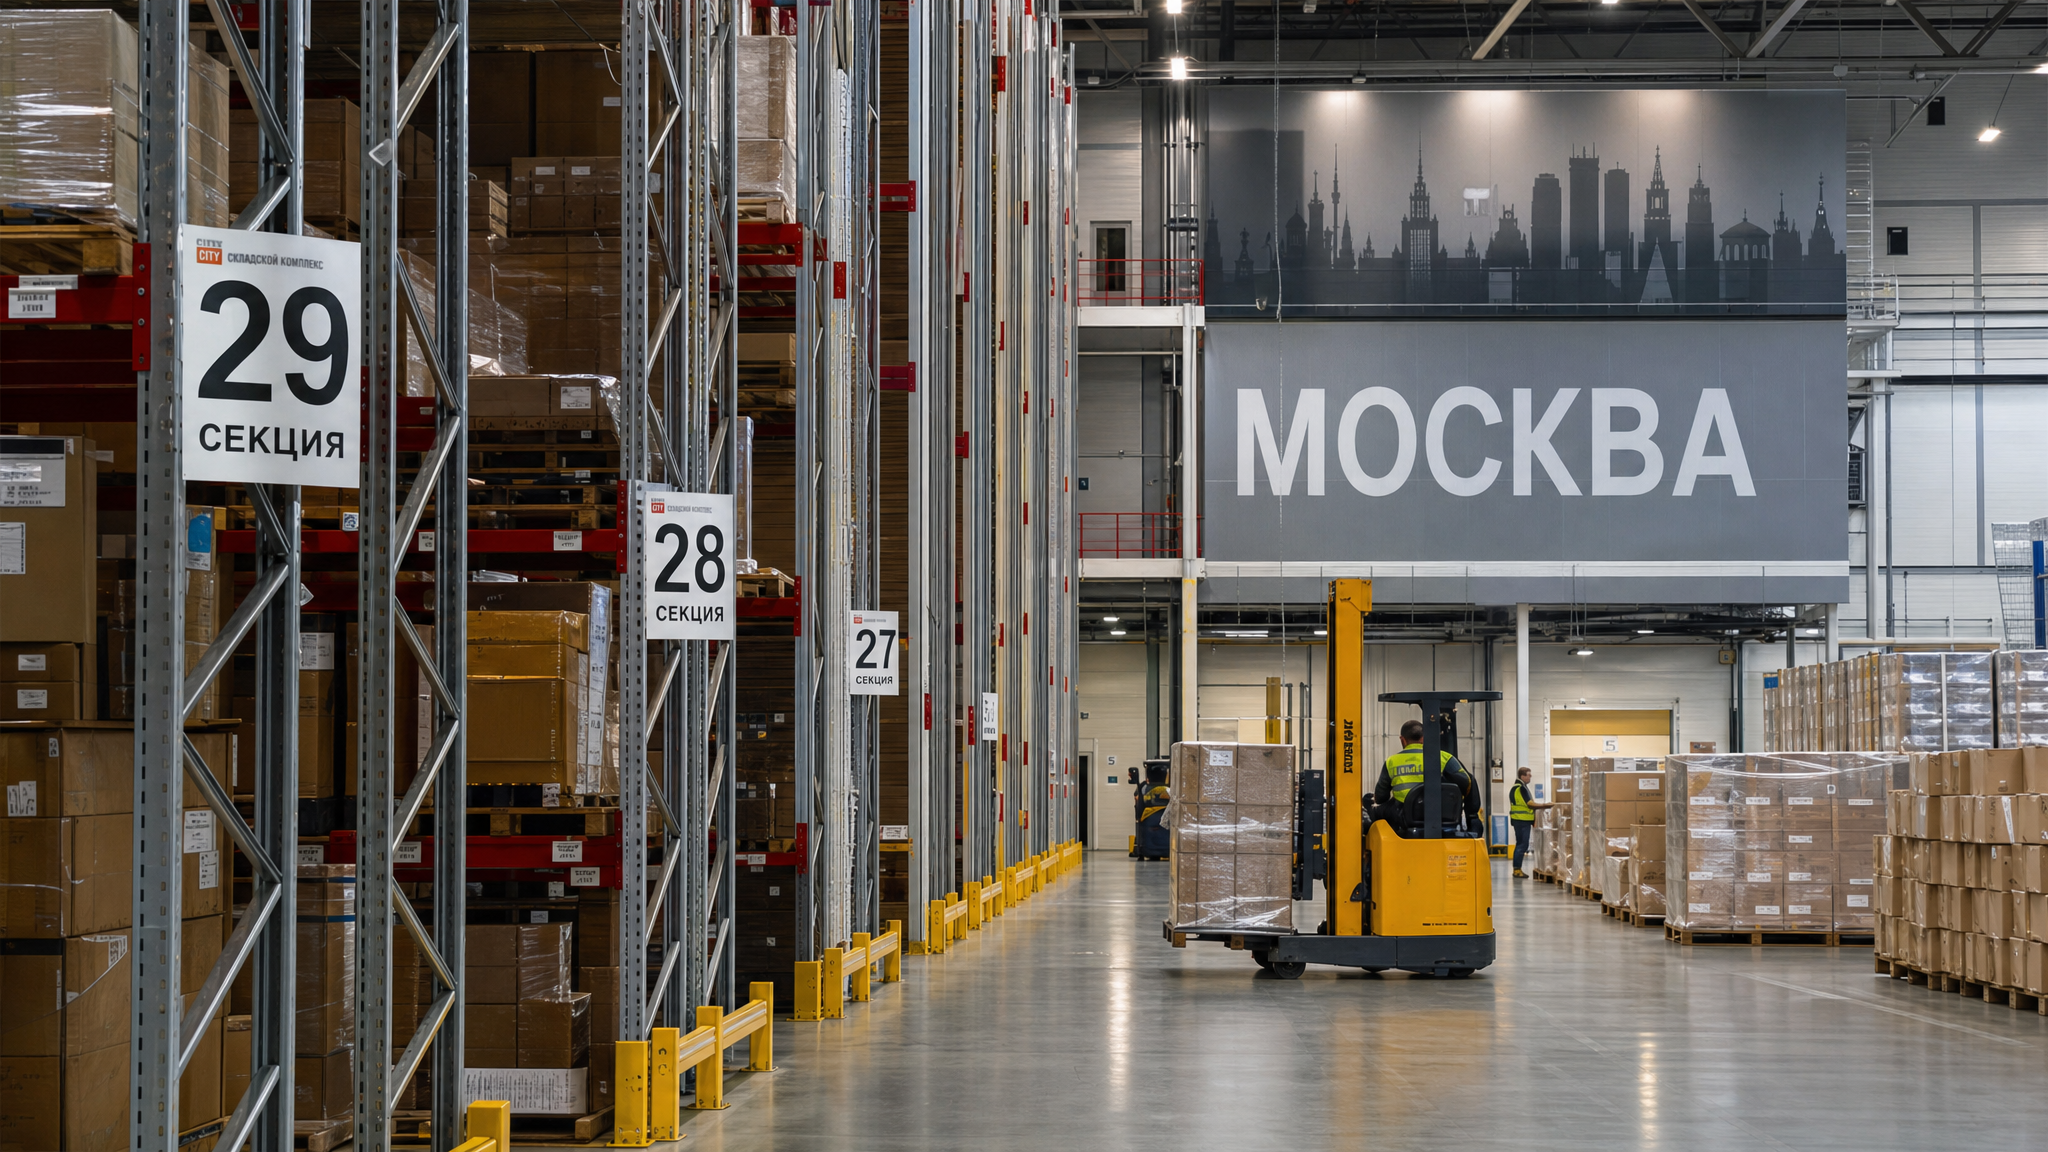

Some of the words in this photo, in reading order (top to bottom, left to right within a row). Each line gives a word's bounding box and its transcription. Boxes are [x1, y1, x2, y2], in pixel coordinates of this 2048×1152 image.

[199, 249, 220, 262] CITY
[227, 252, 278, 266] СКЛАДСКОЙ
[198, 280, 349, 406] 29
[199, 423, 344, 462] СЕКЦИЯ
[1237, 386, 1757, 497] МОСКВА
[654, 523, 725, 593] 28
[656, 605, 723, 624] СЕКЦИЯ
[856, 629, 896, 669] 27
[855, 675, 893, 686] СЕКЦИЯ
[1606, 740, 1616, 752] 5
[1108, 756, 1115, 766] 5
